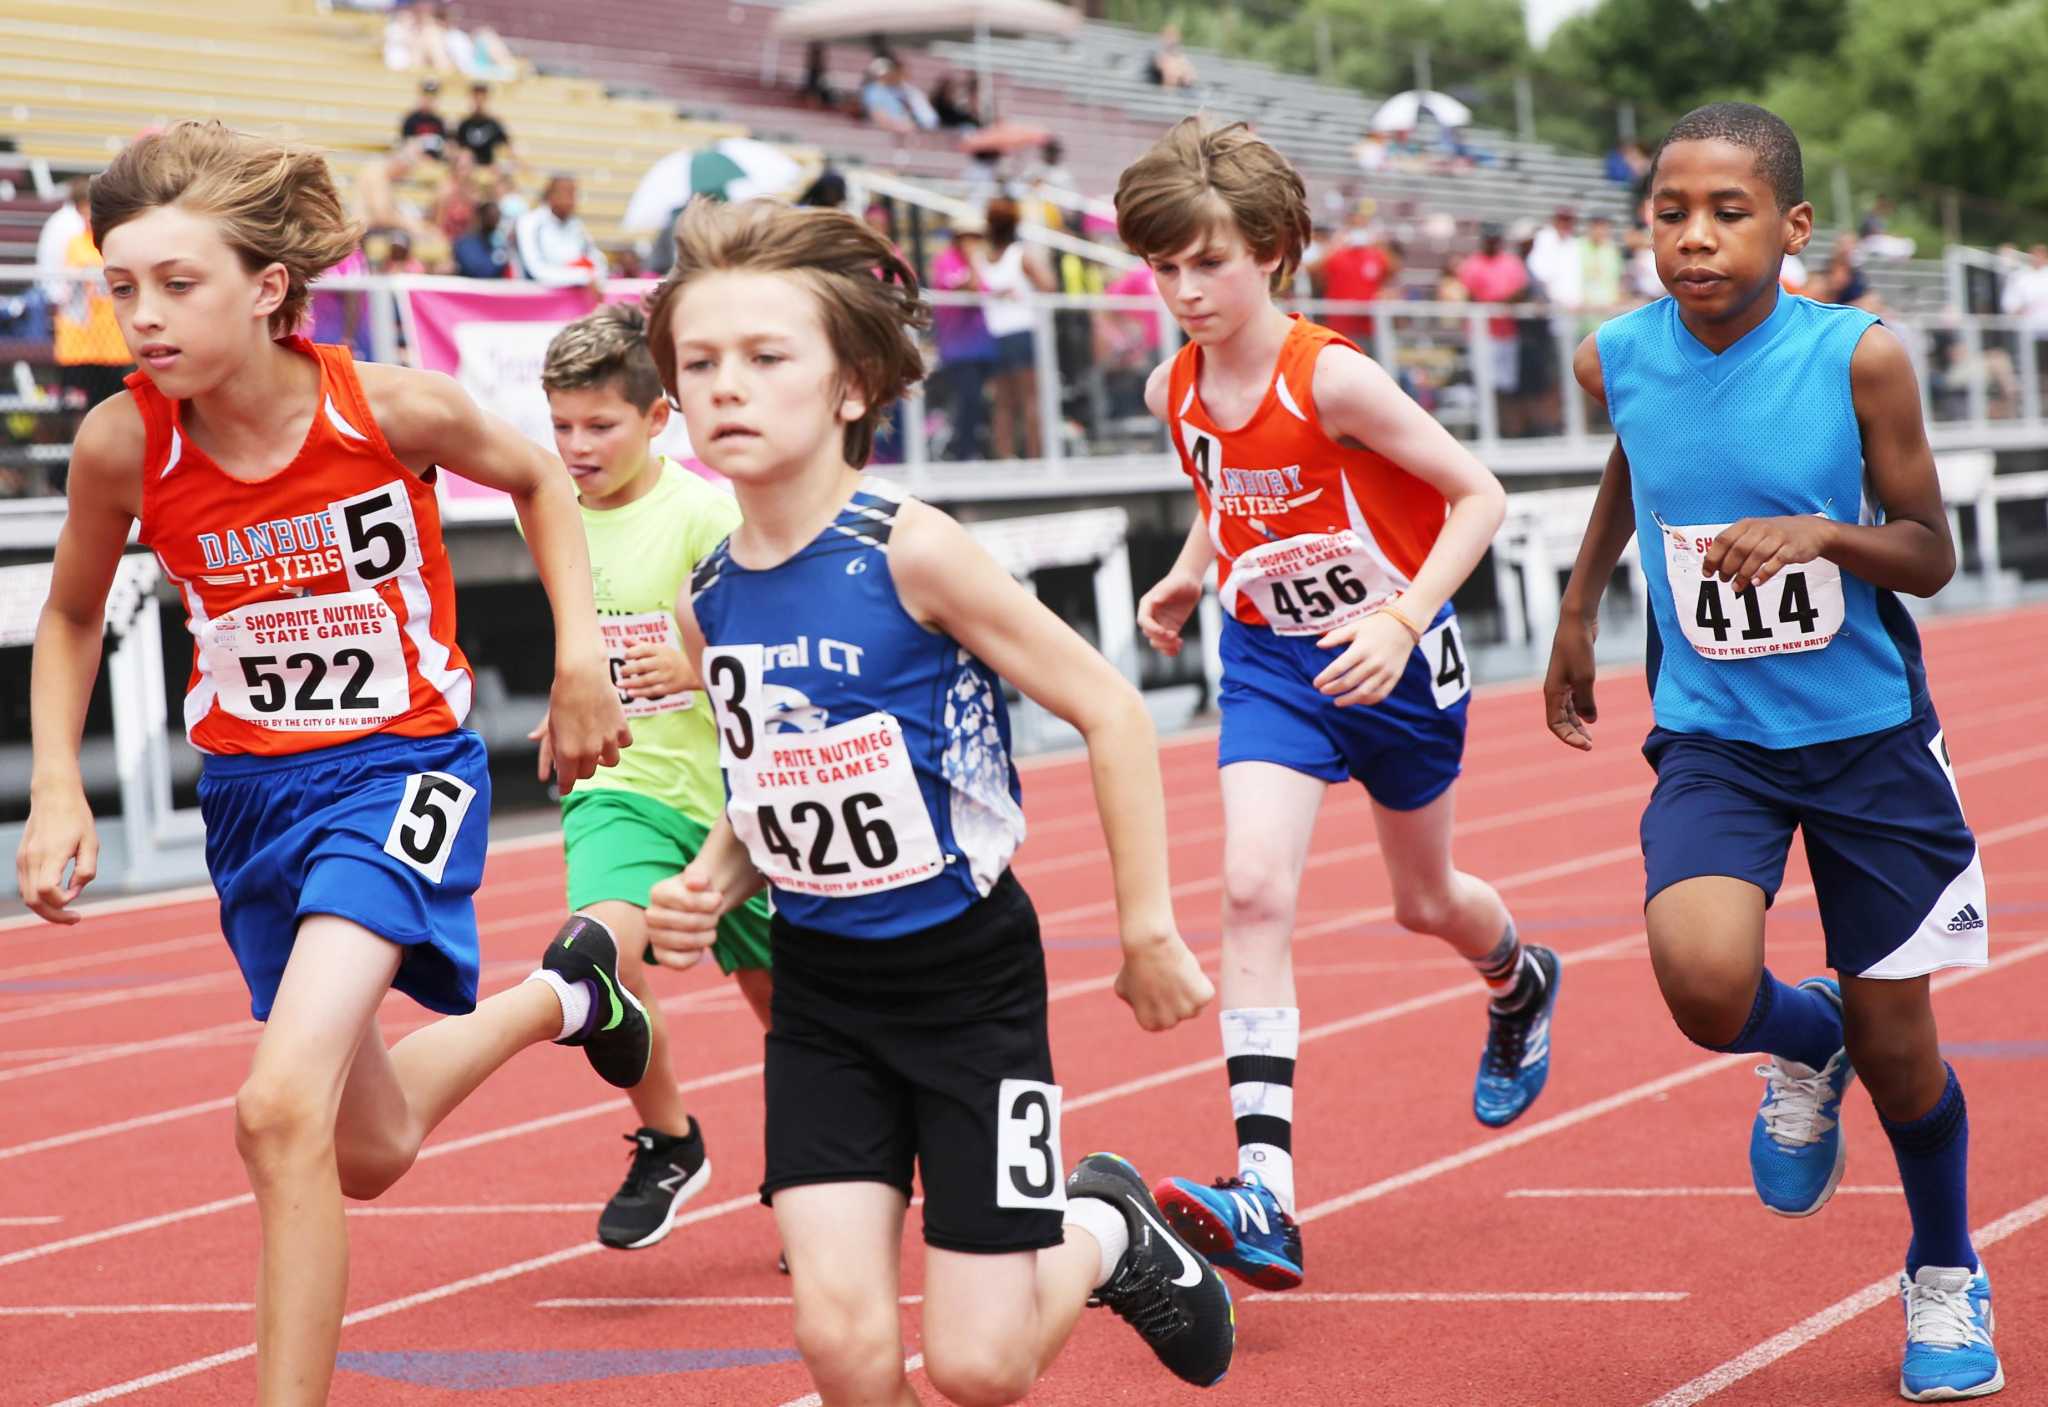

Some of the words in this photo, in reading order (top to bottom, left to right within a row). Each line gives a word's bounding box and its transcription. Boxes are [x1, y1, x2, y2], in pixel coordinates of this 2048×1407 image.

[1221, 464, 1303, 496] NBURY
[1223, 496, 1289, 516] FLYERS
[343, 492, 406, 581] 5
[244, 549, 343, 586] FLYERS
[1257, 546, 1305, 567] SHOPRITE
[1264, 563, 1303, 577] STATE
[1305, 546, 1353, 566] GAMES
[1271, 564, 1367, 623] 456
[1695, 572, 1819, 641] 414
[245, 608, 319, 631] SHOPRITE
[323, 602, 387, 624] NUTMEG
[255, 628, 310, 644] STATE
[317, 621, 382, 639] GAMES
[818, 638, 864, 677] CT
[1437, 626, 1464, 690] 4
[1719, 647, 1728, 655] BY
[1731, 646, 1746, 655] THE
[1748, 645, 1767, 654] CITY
[1770, 643, 1781, 652] OF
[1783, 641, 1802, 651] NEW
[239, 648, 380, 713] 522
[272, 719, 282, 727] BY
[285, 718, 300, 727] THE
[303, 718, 322, 727] CITY
[325, 717, 336, 726] OF
[339, 717, 358, 726] NEW
[710, 655, 754, 760] 3
[820, 729, 893, 764] NUTMEG
[757, 772, 809, 788] STATE
[817, 753, 889, 784] GAMES
[400, 774, 462, 864] 5
[757, 792, 898, 876] 426
[846, 881, 858, 891] OF
[862, 877, 884, 888] NEW
[1947, 919, 1984, 931] adidas
[1009, 1090, 1055, 1199] 3
